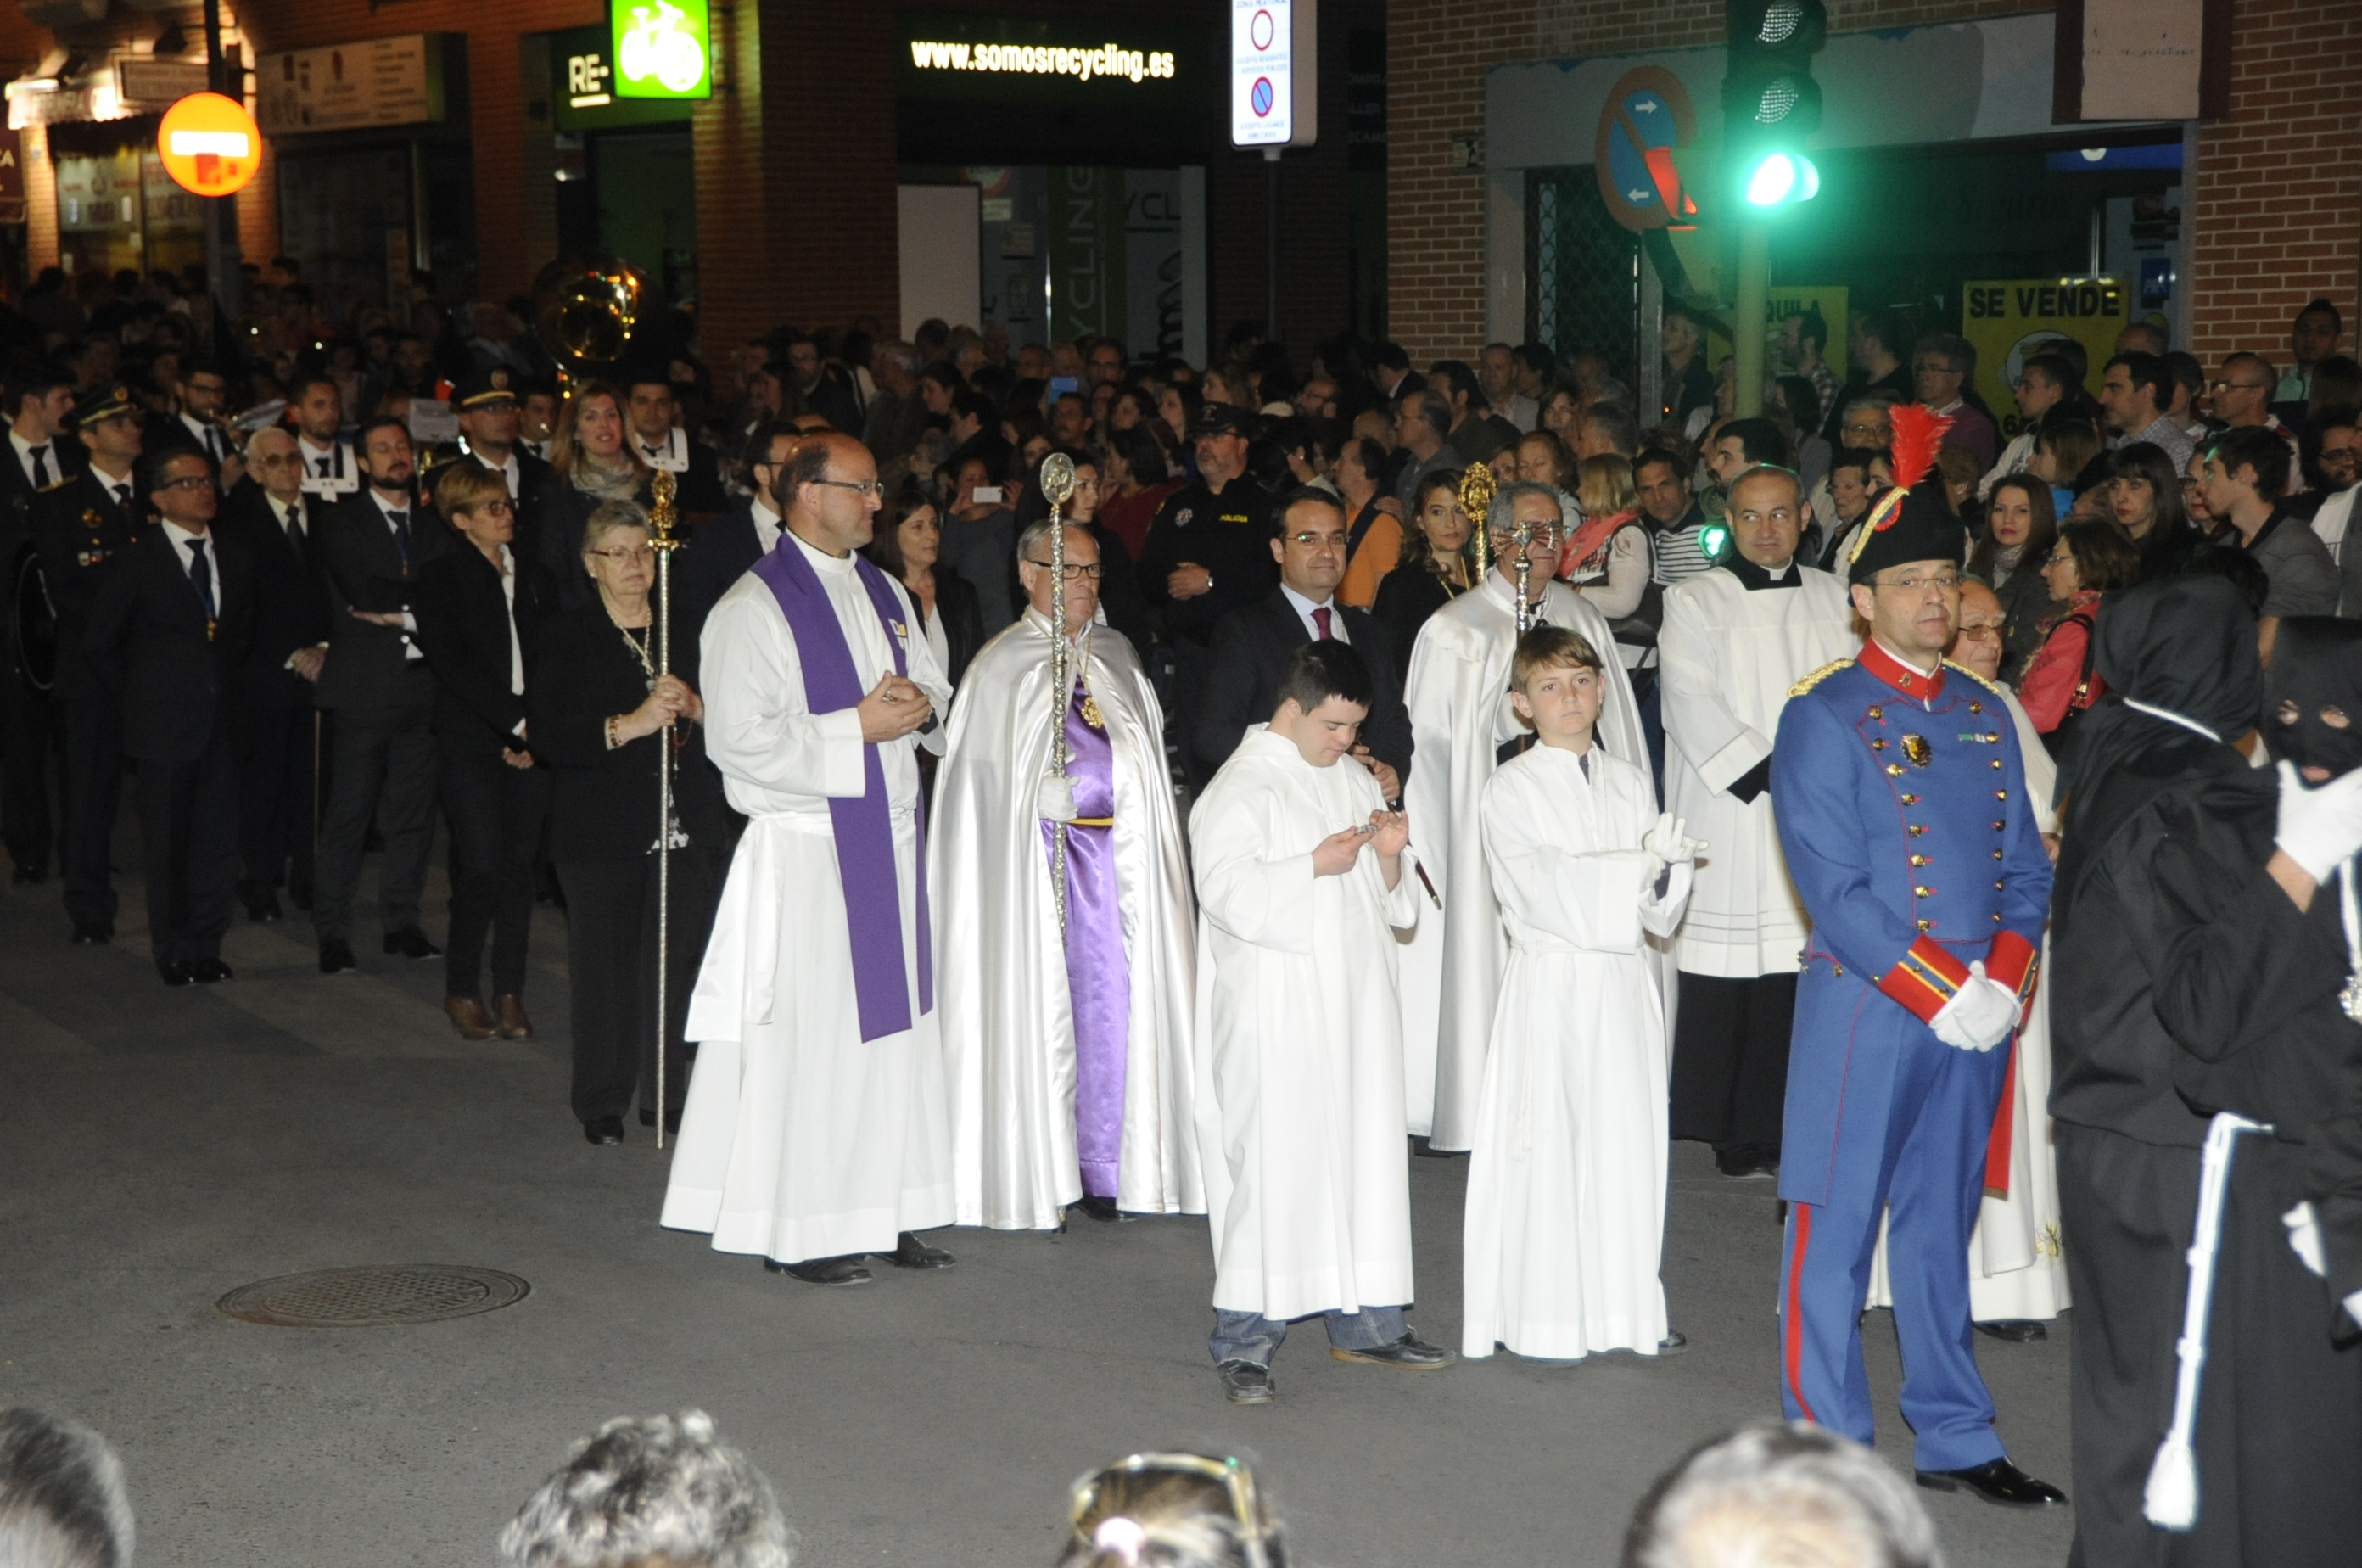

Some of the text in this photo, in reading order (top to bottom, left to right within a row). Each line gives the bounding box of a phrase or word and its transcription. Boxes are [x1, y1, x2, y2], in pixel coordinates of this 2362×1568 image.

[911, 41, 1174, 82] www.somosrecycling.es
[1969, 286, 2121, 318] SE VENDE
